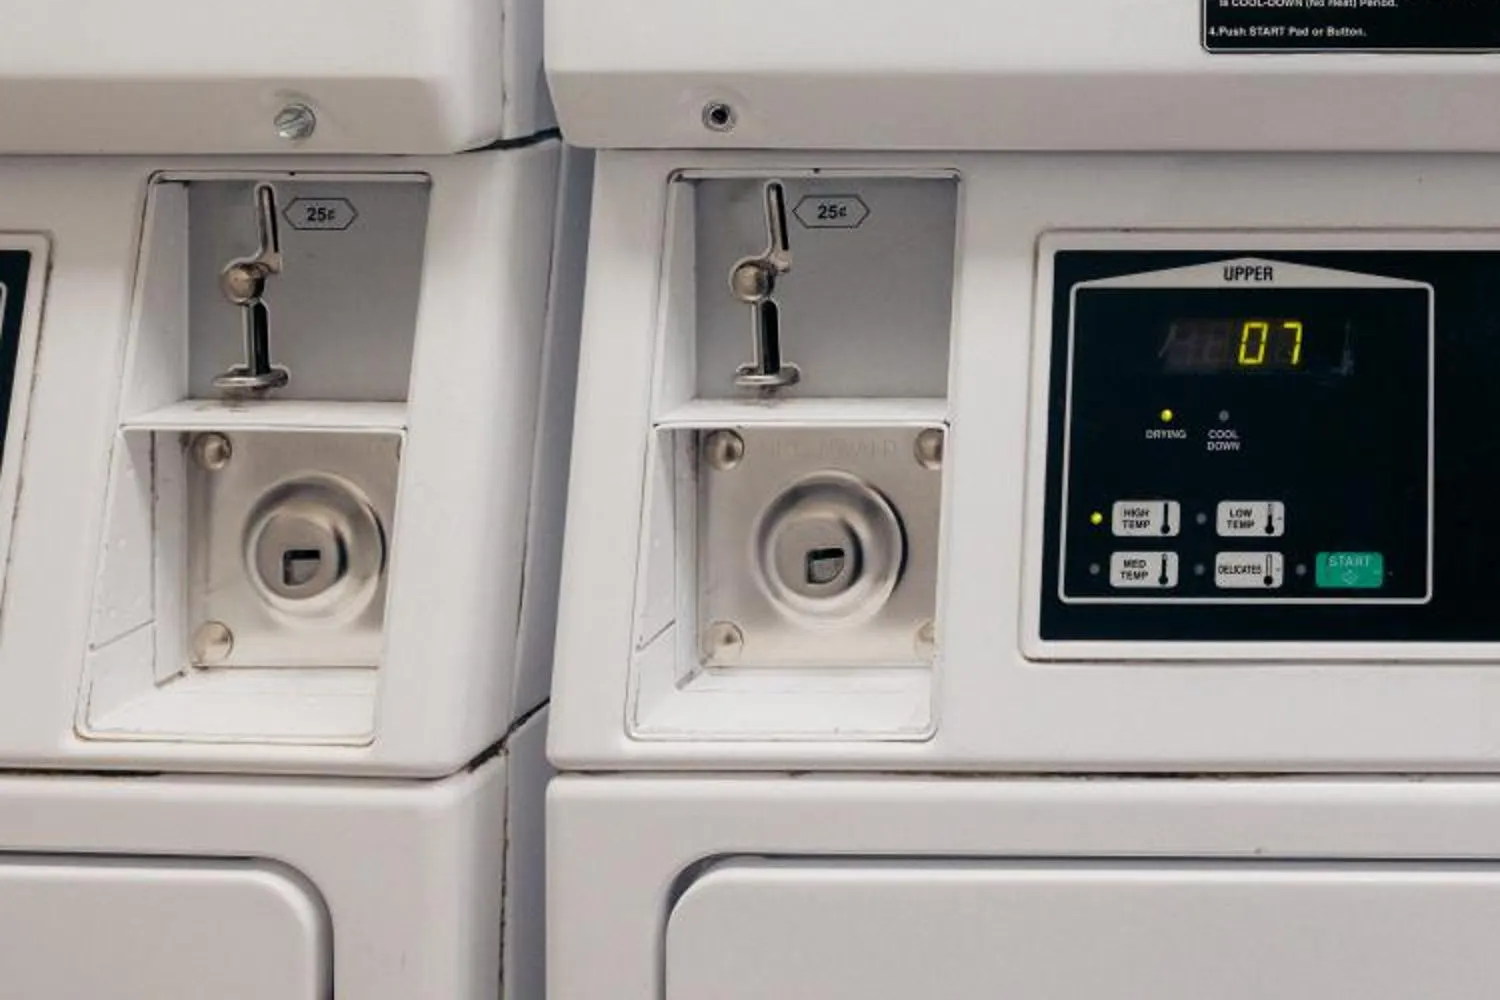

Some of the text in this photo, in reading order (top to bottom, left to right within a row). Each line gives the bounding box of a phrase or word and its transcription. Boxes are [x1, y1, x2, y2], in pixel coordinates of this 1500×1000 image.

[1249, 27, 1285, 37] START
[1289, 27, 1309, 37] Pad
[1312, 27, 1324, 37] or
[1327, 27, 1366, 37] Button.
[307, 206, 336, 221] 25¢
[817, 204, 847, 219] 25¢
[1223, 267, 1273, 281] UPPER
[1238, 321, 1303, 365] 07
[1146, 430, 1186, 439] DRYING
[1208, 430, 1239, 439] COOL
[1207, 441, 1241, 451] DOWN
[1123, 508, 1150, 518] HIGH
[1229, 508, 1252, 518] LOW
[1122, 520, 1151, 530] TEMP
[1226, 520, 1255, 530] TEMP
[1123, 559, 1146, 569] MED
[1328, 556, 1370, 567] START
[1218, 565, 1262, 575] DELICATES
[1120, 571, 1149, 580] TEMP
